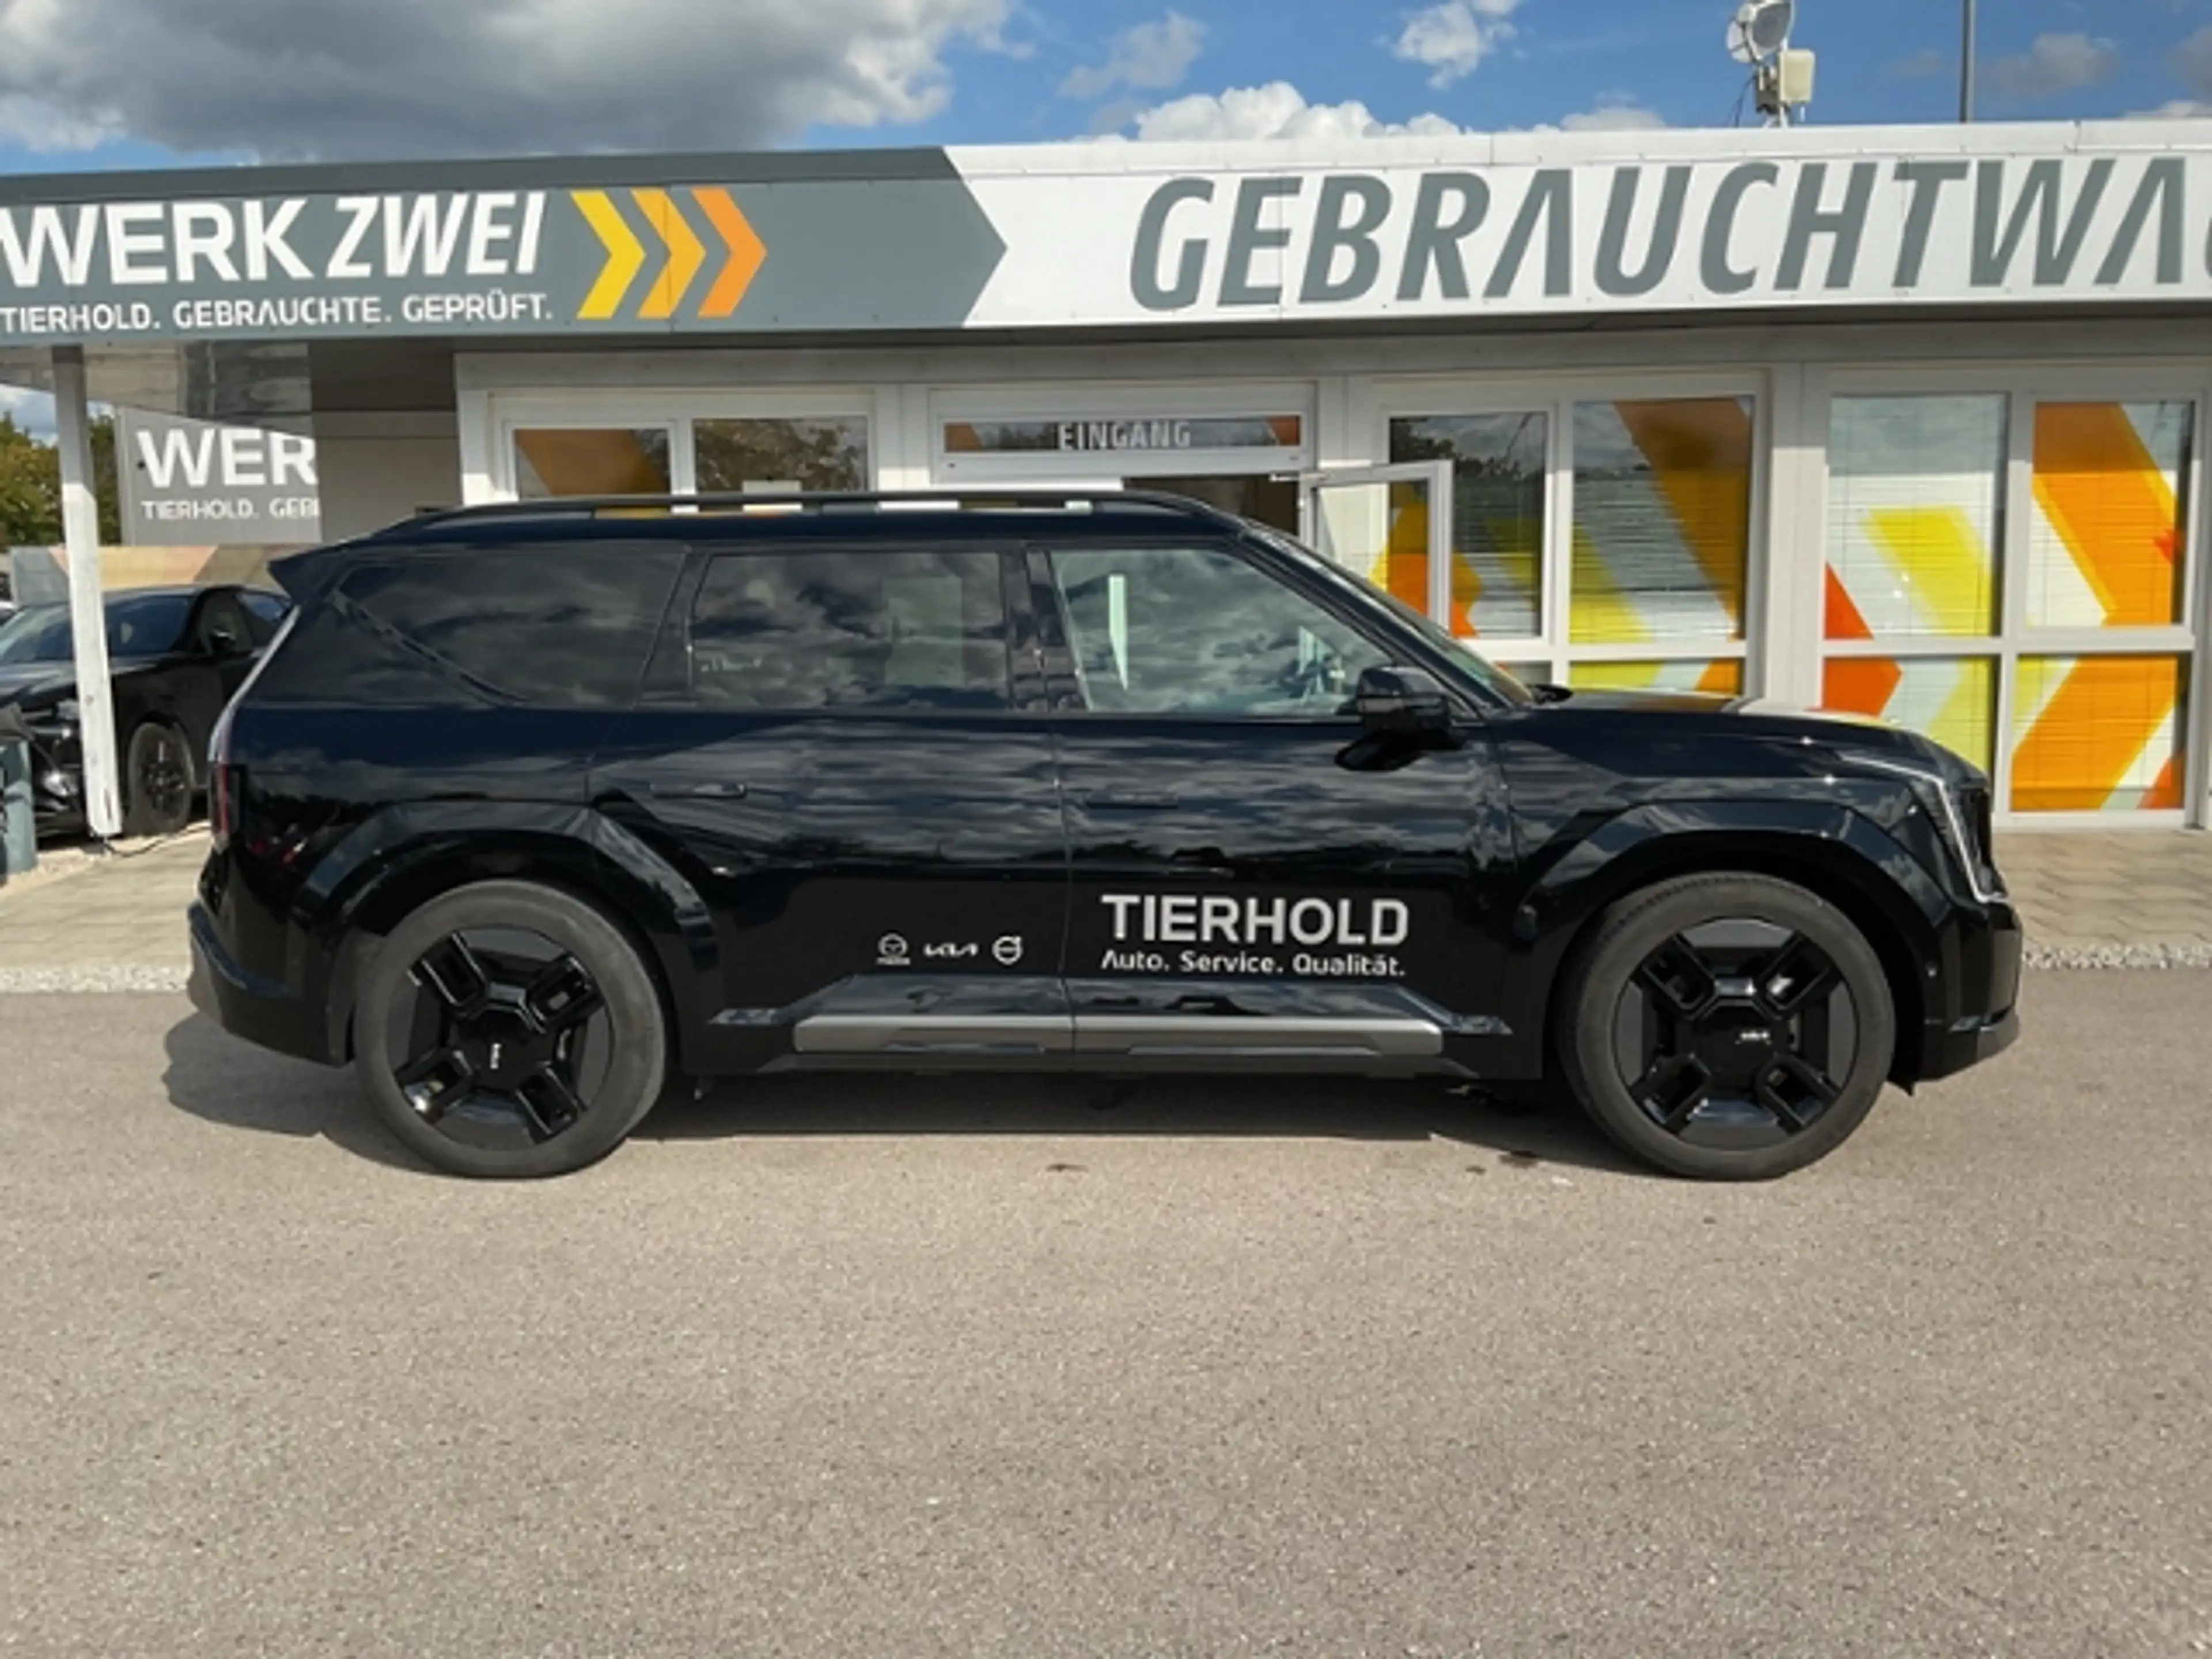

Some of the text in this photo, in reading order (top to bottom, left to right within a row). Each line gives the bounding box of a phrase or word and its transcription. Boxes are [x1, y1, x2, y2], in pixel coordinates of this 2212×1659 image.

[0, 191, 546, 287] WERK ZWEI
[1130, 157, 2212, 311] GEBRAUCHTWA
[1, 287, 554, 334] TIERHOLD. GEBRAUCHTE. GEPRÜFT.
[1058, 421, 1191, 450] EINGANG
[1101, 894, 1409, 945] TIERHOLD
[1101, 950, 1404, 976] Auto. Service. Qualität.
